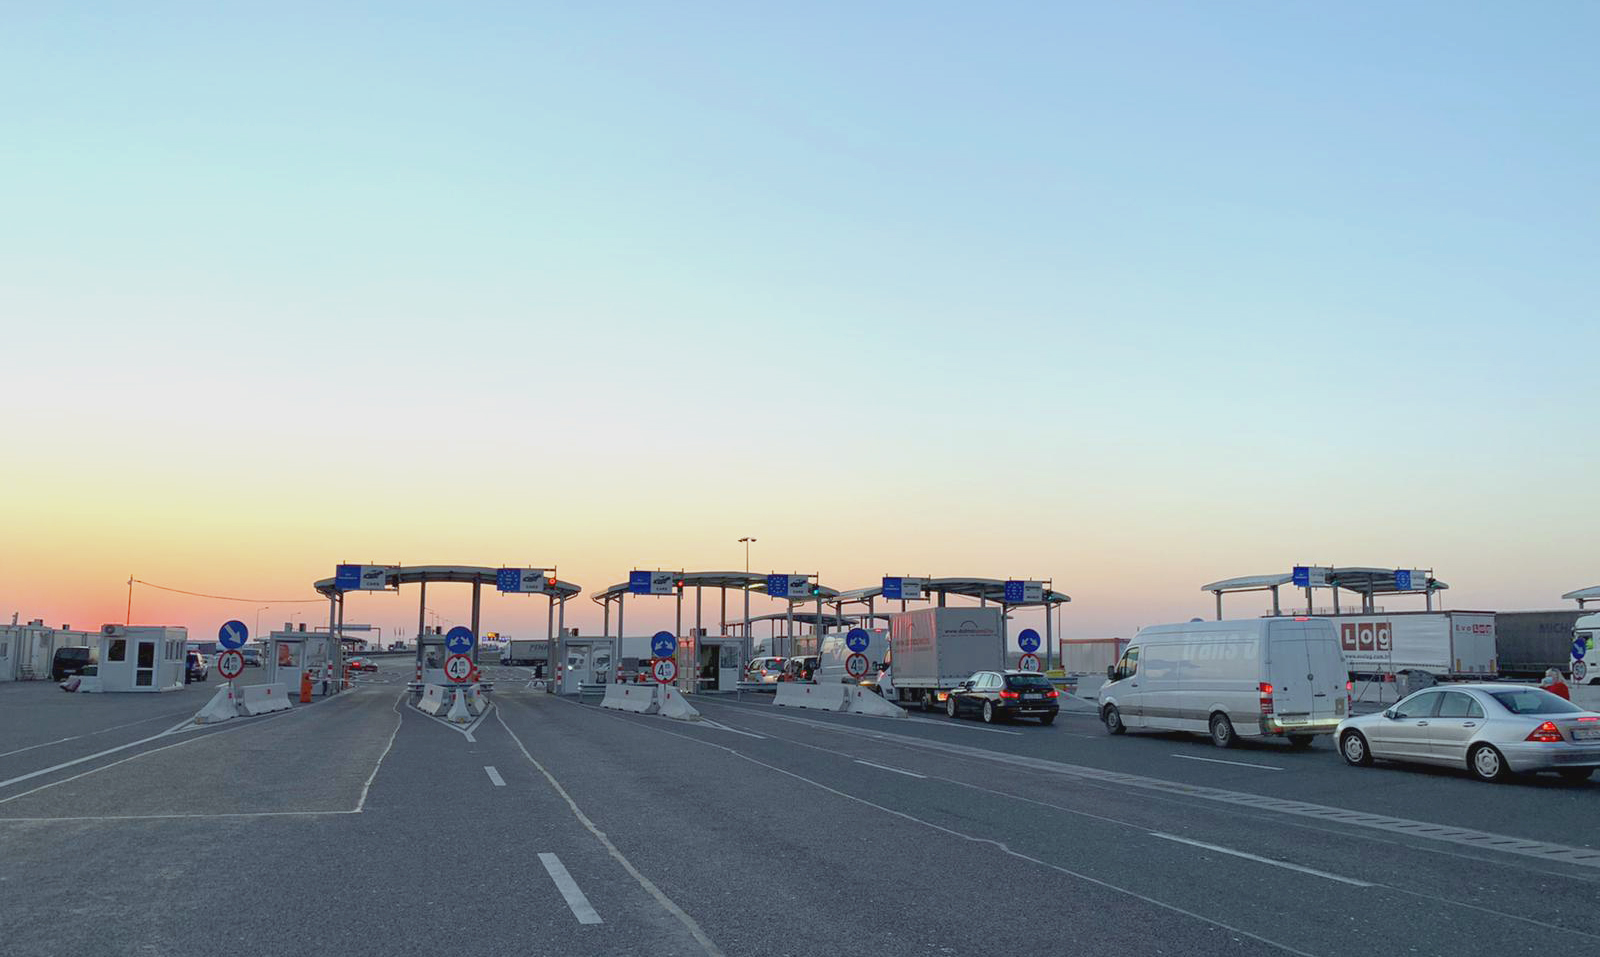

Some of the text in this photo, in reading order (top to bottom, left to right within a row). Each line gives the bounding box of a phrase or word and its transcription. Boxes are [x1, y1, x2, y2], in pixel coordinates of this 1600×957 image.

[223, 657, 230, 671] 4
[450, 661, 458, 673] 4
[657, 664, 664, 676] 4
[850, 659, 857, 671] 4
